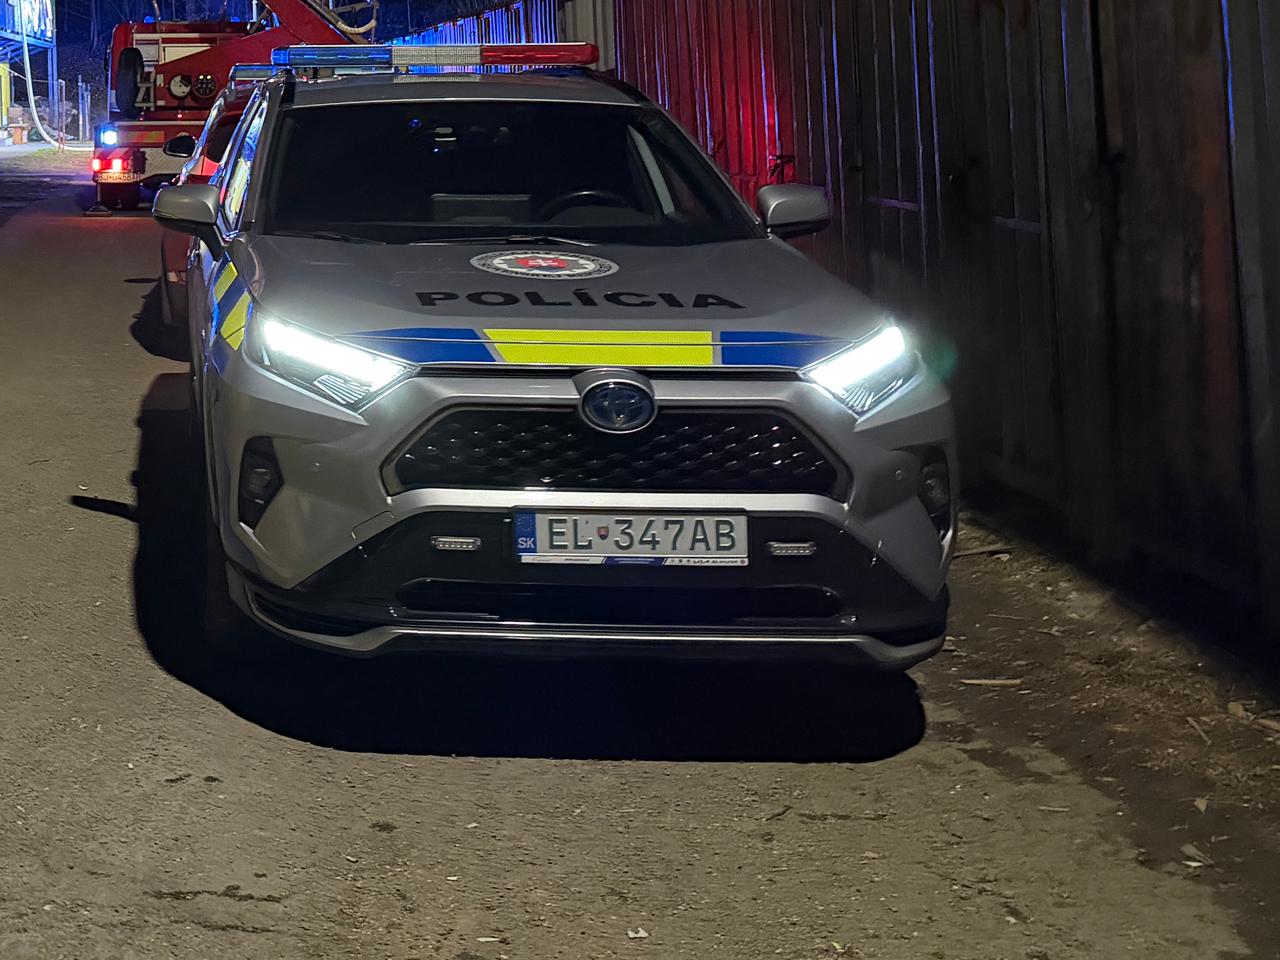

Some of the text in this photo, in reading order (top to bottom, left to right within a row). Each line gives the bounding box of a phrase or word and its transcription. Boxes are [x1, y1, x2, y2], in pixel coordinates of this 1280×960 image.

[415, 288, 747, 309] POLÍCIA
[518, 537, 535, 549] SK
[614, 517, 736, 552] 347AB
